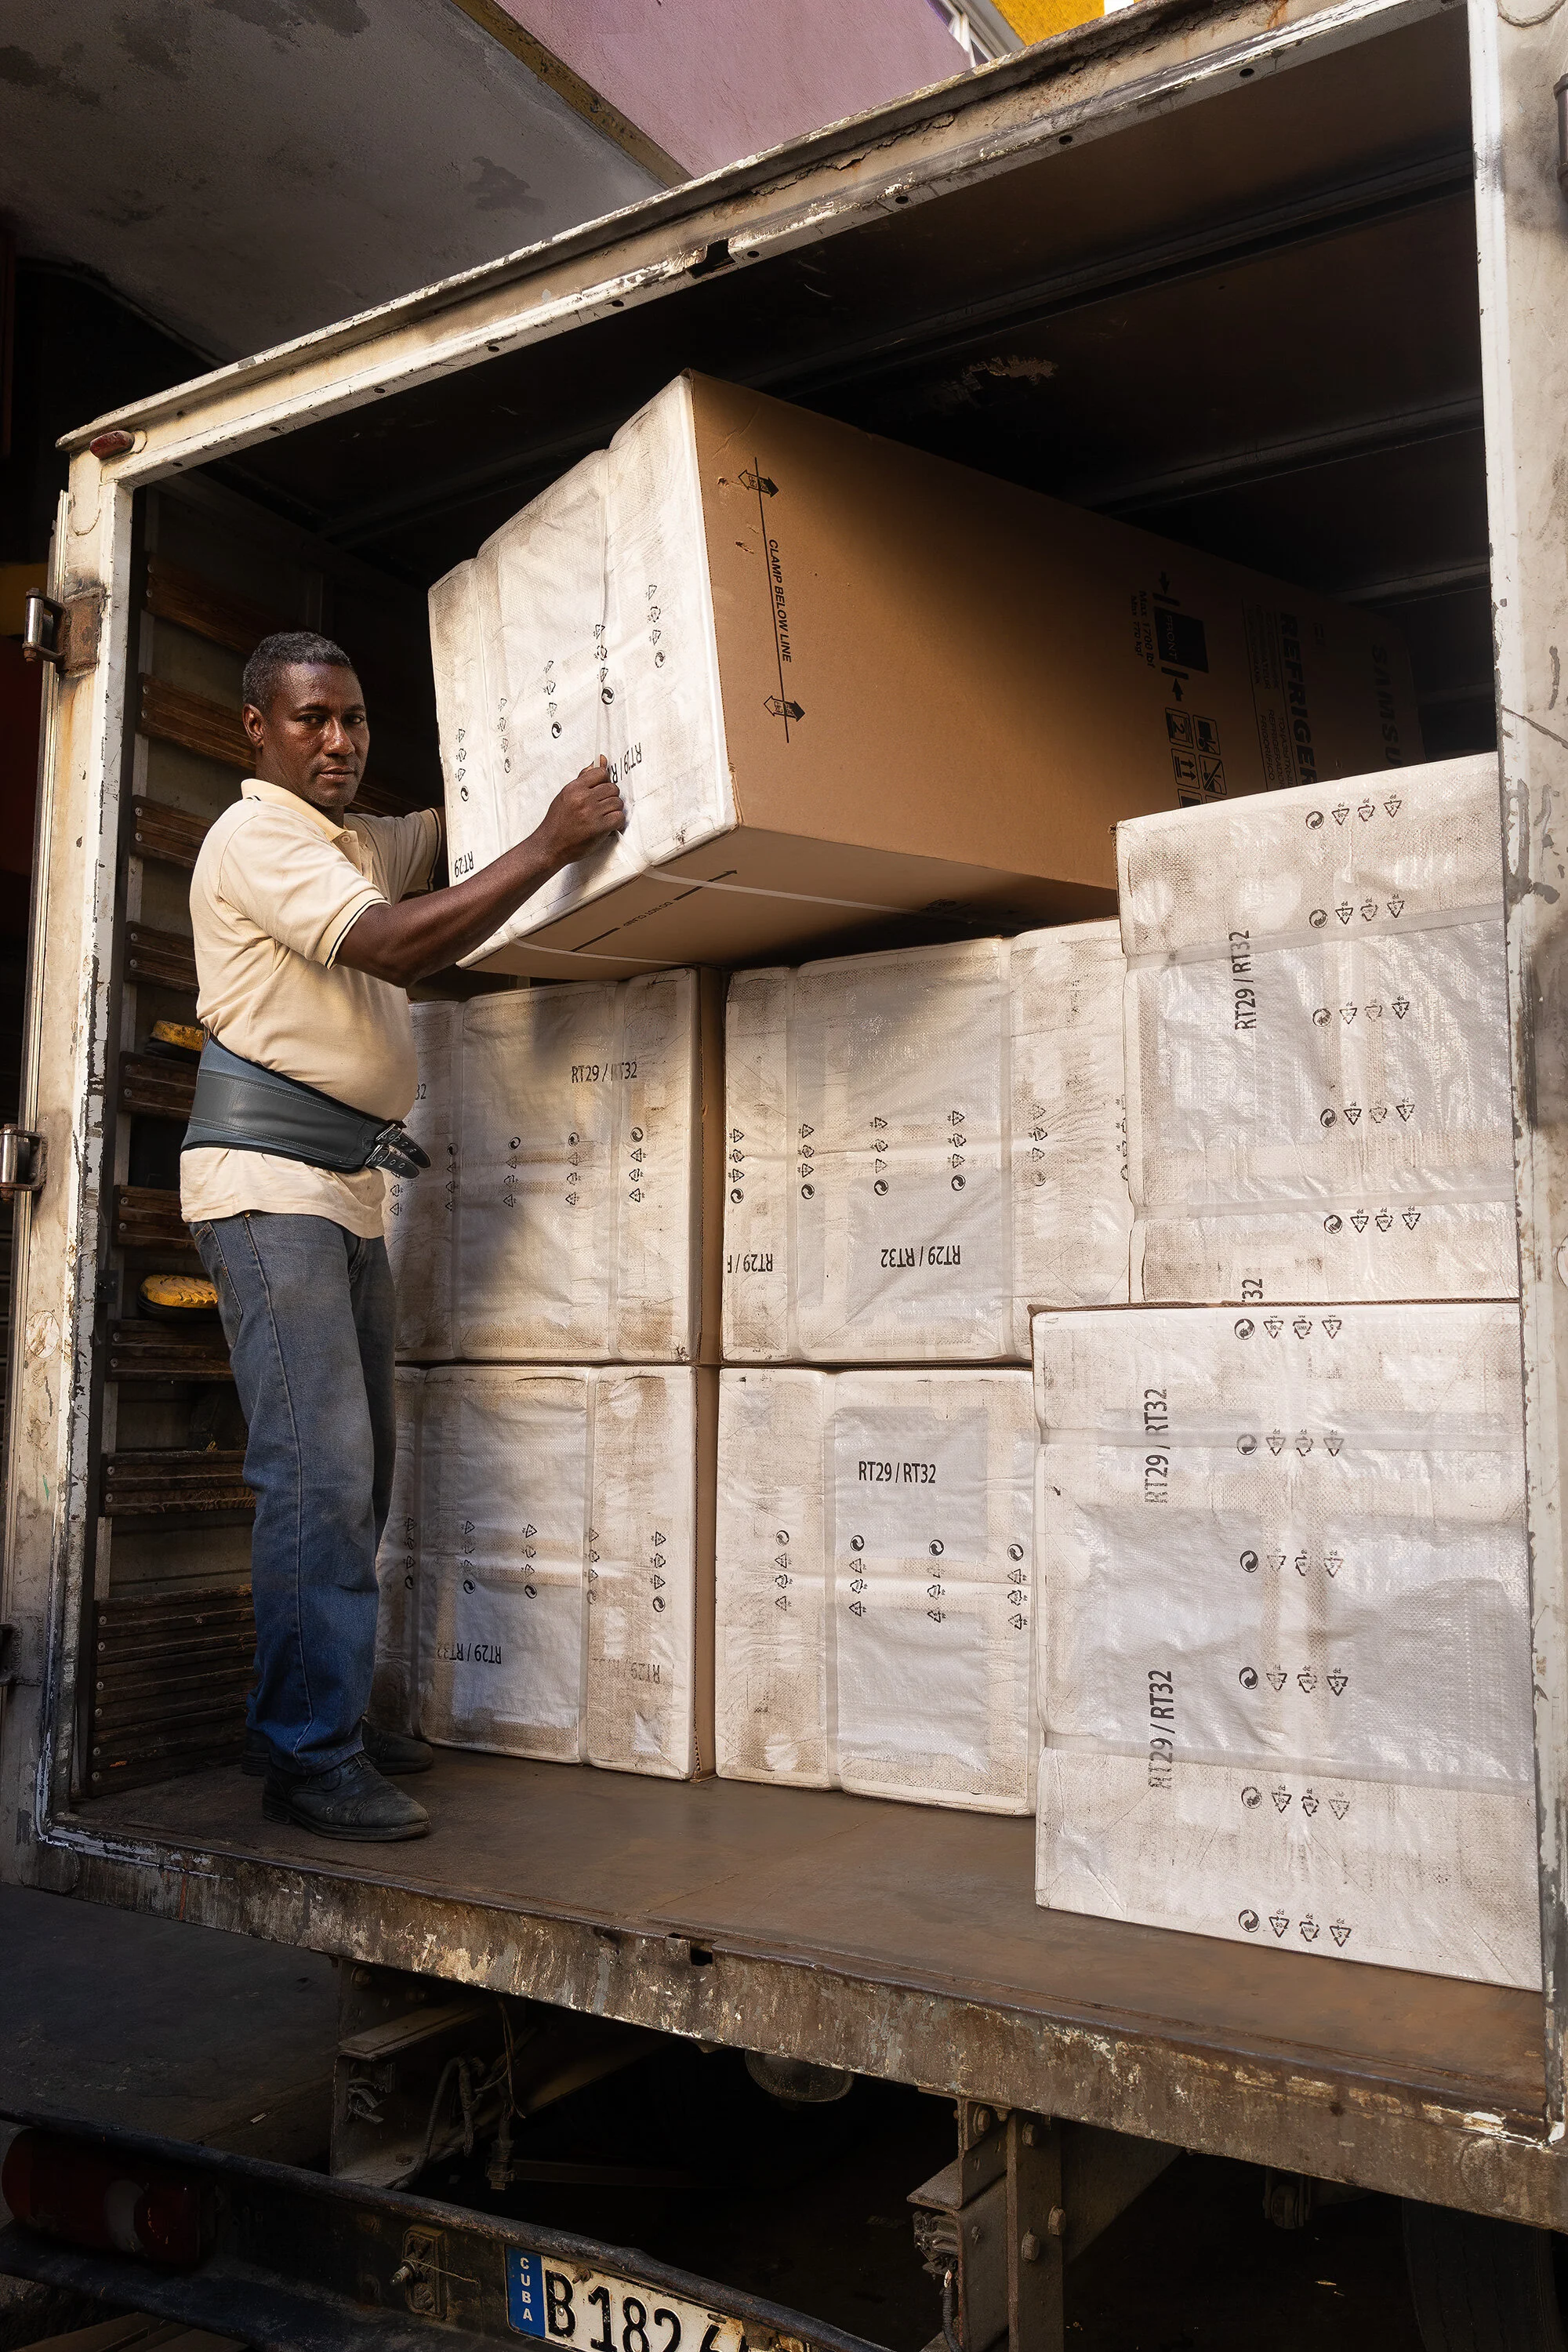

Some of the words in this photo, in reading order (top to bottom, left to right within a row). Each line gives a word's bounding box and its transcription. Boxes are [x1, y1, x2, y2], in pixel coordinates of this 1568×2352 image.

[769, 539, 782, 584] CLAMP
[775, 586, 789, 632] BELOW
[1138, 590, 1148, 617] Max
[780, 633, 792, 662] LINE
[1142, 622, 1153, 650] 1700
[1166, 614, 1178, 660] FRONT
[1280, 612, 1317, 785] REFRIGER
[1372, 644, 1402, 765] SAMSU
[624, 742, 642, 775] RT9
[1229, 931, 1251, 974] RT32
[1235, 989, 1257, 1030] RT29
[572, 1065, 600, 1083] RT29
[743, 1254, 773, 1272] RT29
[880, 1247, 916, 1268] RT32
[928, 1245, 961, 1266] RT29
[1242, 1279, 1263, 1302] 32
[1144, 1388, 1170, 1436] RT32
[858, 1461, 892, 1482] RT29
[903, 1463, 936, 1483] RT32
[1145, 1454, 1170, 1504] RT29
[474, 1644, 502, 1664] RT29
[1148, 1671, 1174, 1720] RT32
[1148, 1737, 1174, 1789] RT29
[520, 2256, 533, 2322] CUBA
